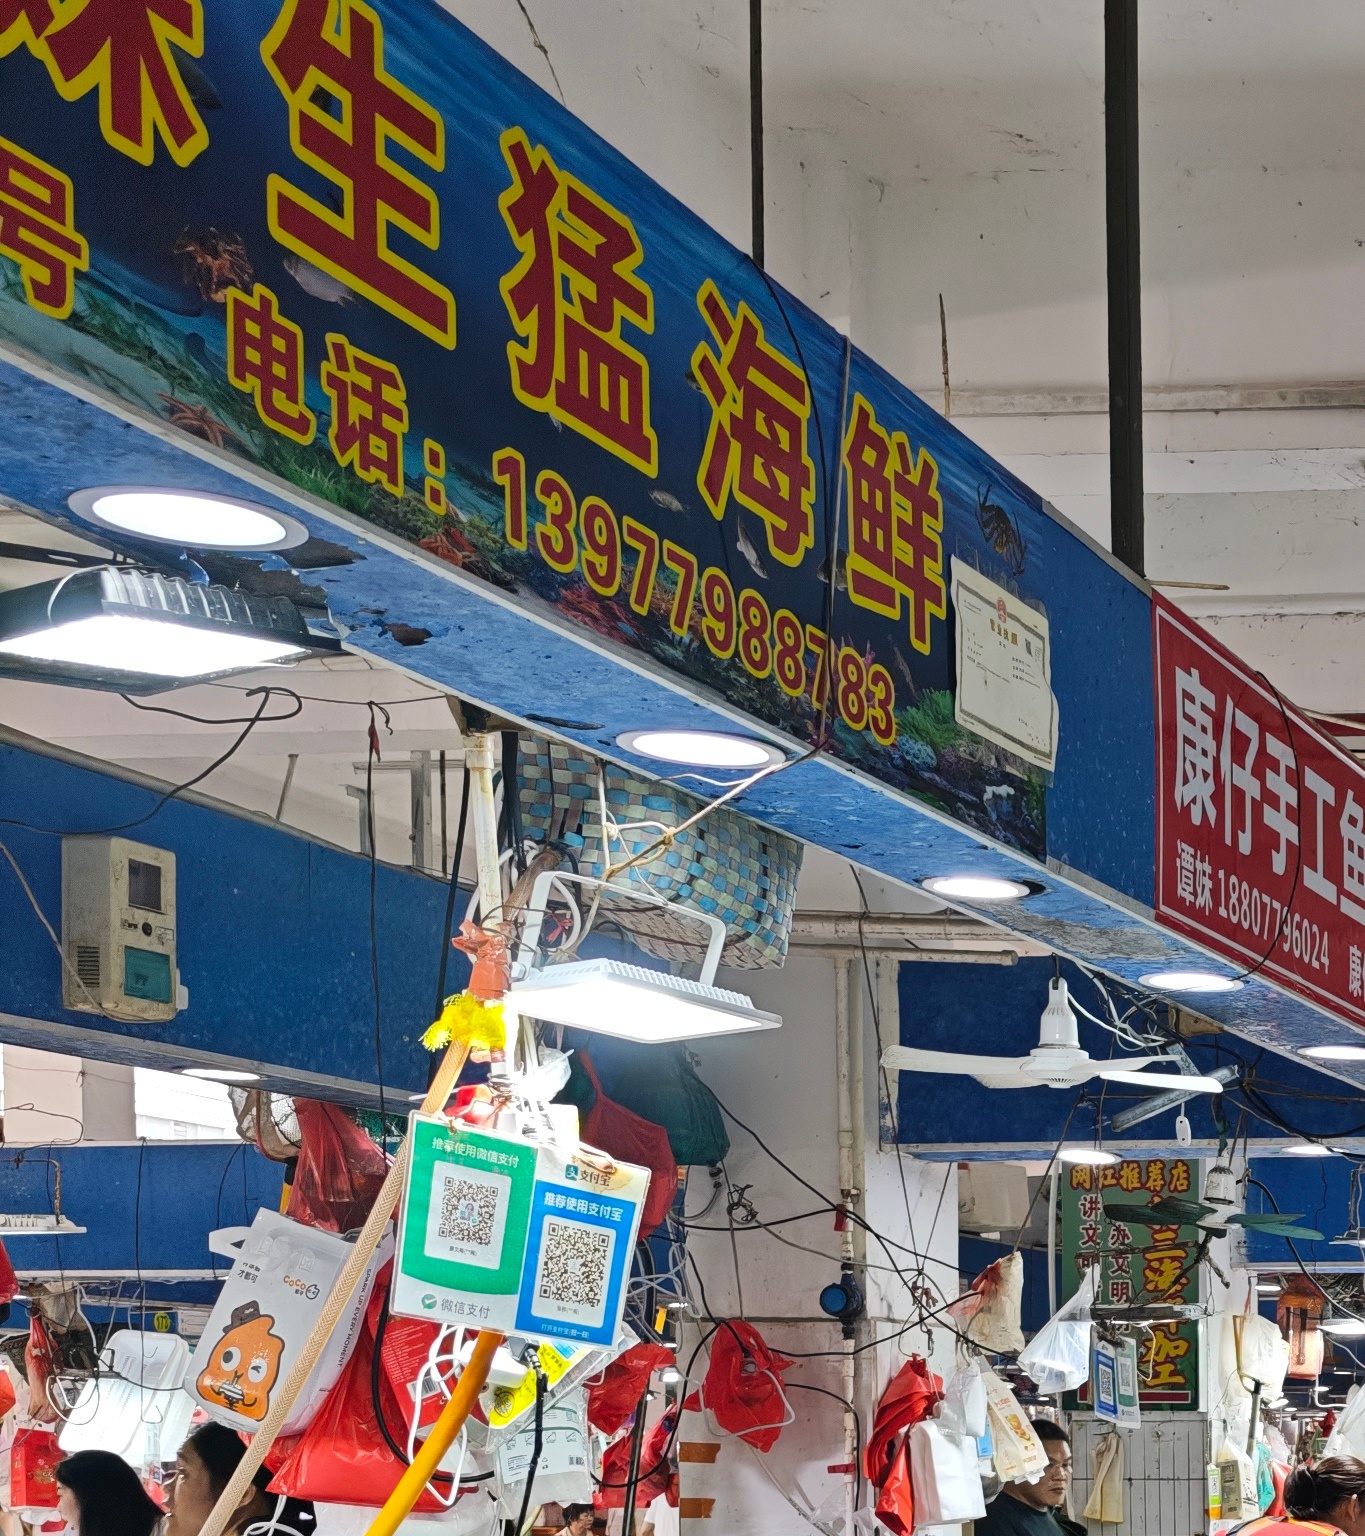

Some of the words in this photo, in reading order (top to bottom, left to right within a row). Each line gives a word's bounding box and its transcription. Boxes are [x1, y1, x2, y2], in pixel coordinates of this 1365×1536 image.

[493, 447, 897, 746] 13977988783
[1176, 839, 1213, 917] 谭妹
[1218, 869, 1330, 976] 18807796024
[432, 1136, 520, 1169] 推荐使用微信支付
[580, 1168, 612, 1188] 支付宝
[543, 1191, 625, 1223] 推荐使用支付宝
[283, 1274, 306, 1291] CoCo
[348, 1306, 361, 1333] EVERY
[441, 1298, 491, 1320] 微信支付
[337, 1333, 352, 1368] MOMENT
